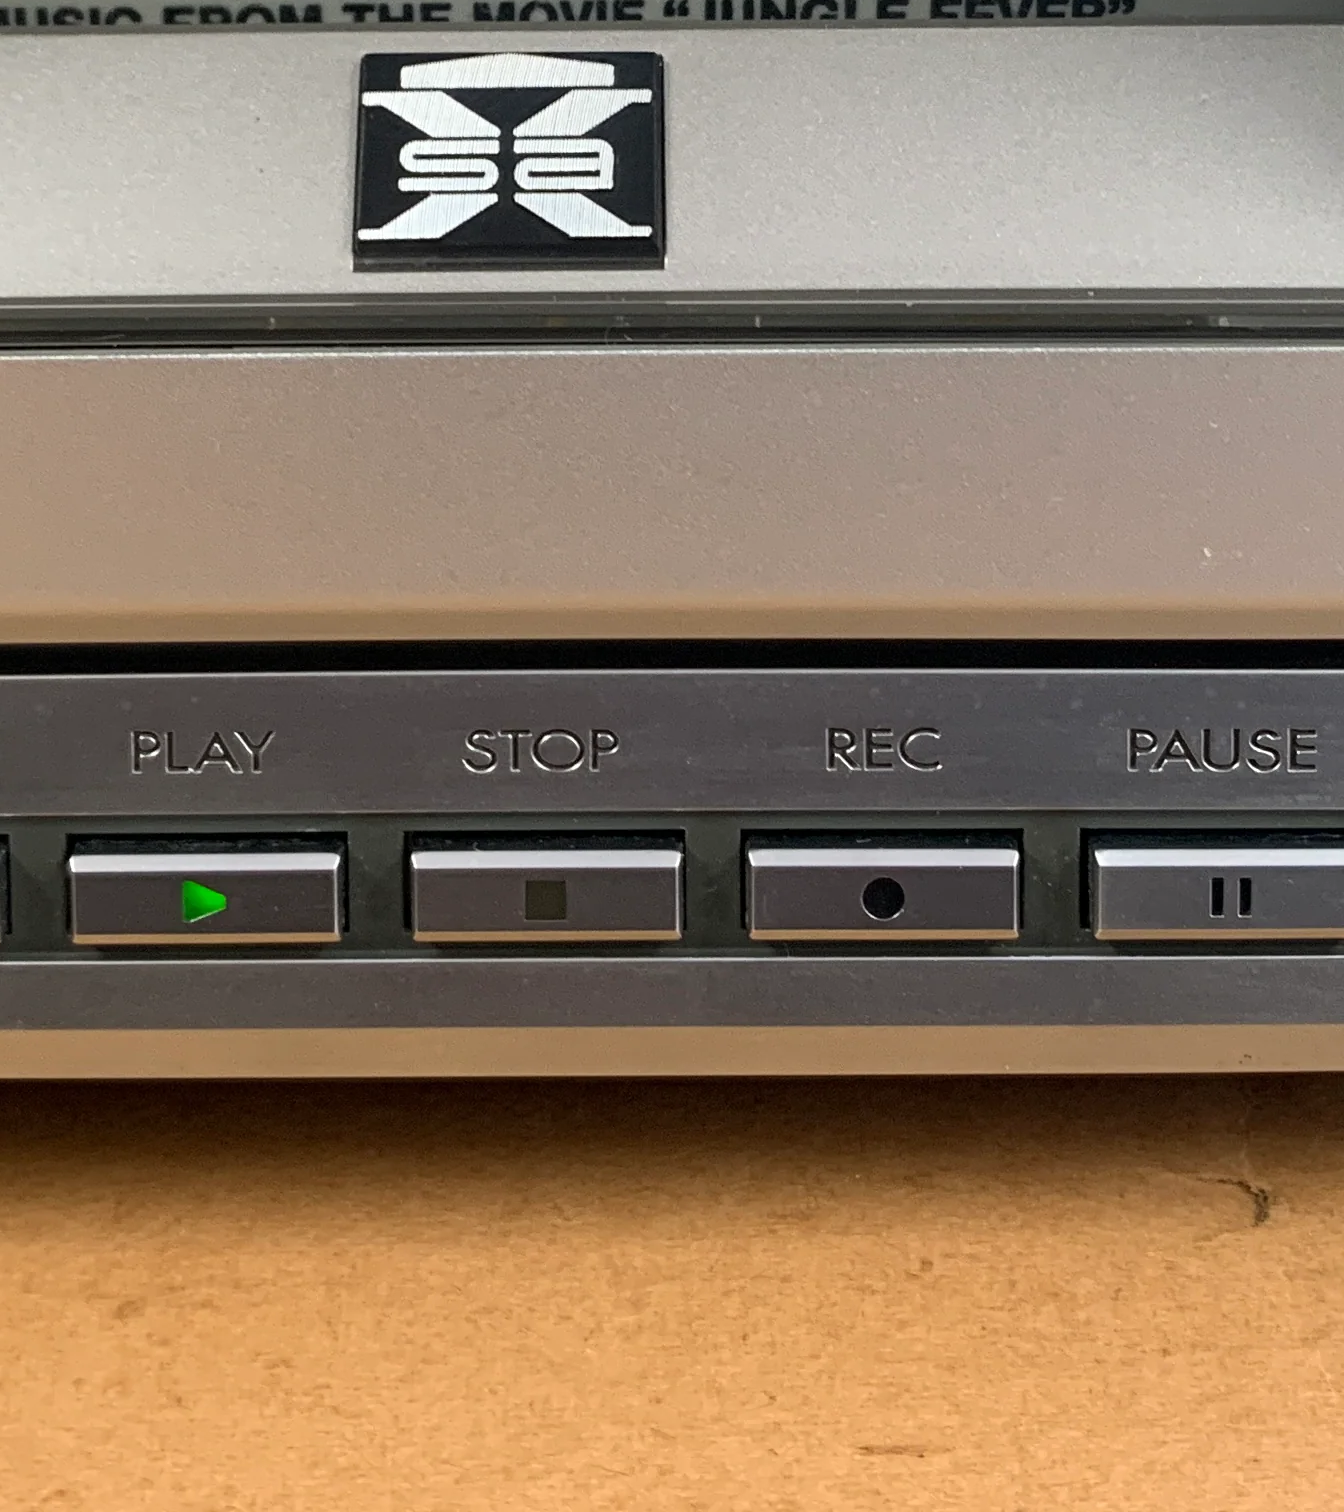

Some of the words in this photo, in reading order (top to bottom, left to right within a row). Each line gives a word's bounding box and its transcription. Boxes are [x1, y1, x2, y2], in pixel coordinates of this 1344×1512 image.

[129, 729, 275, 775] PLAY
[461, 728, 621, 774] STOP
[825, 728, 943, 774] REC
[1126, 726, 1320, 774] PAUSE
